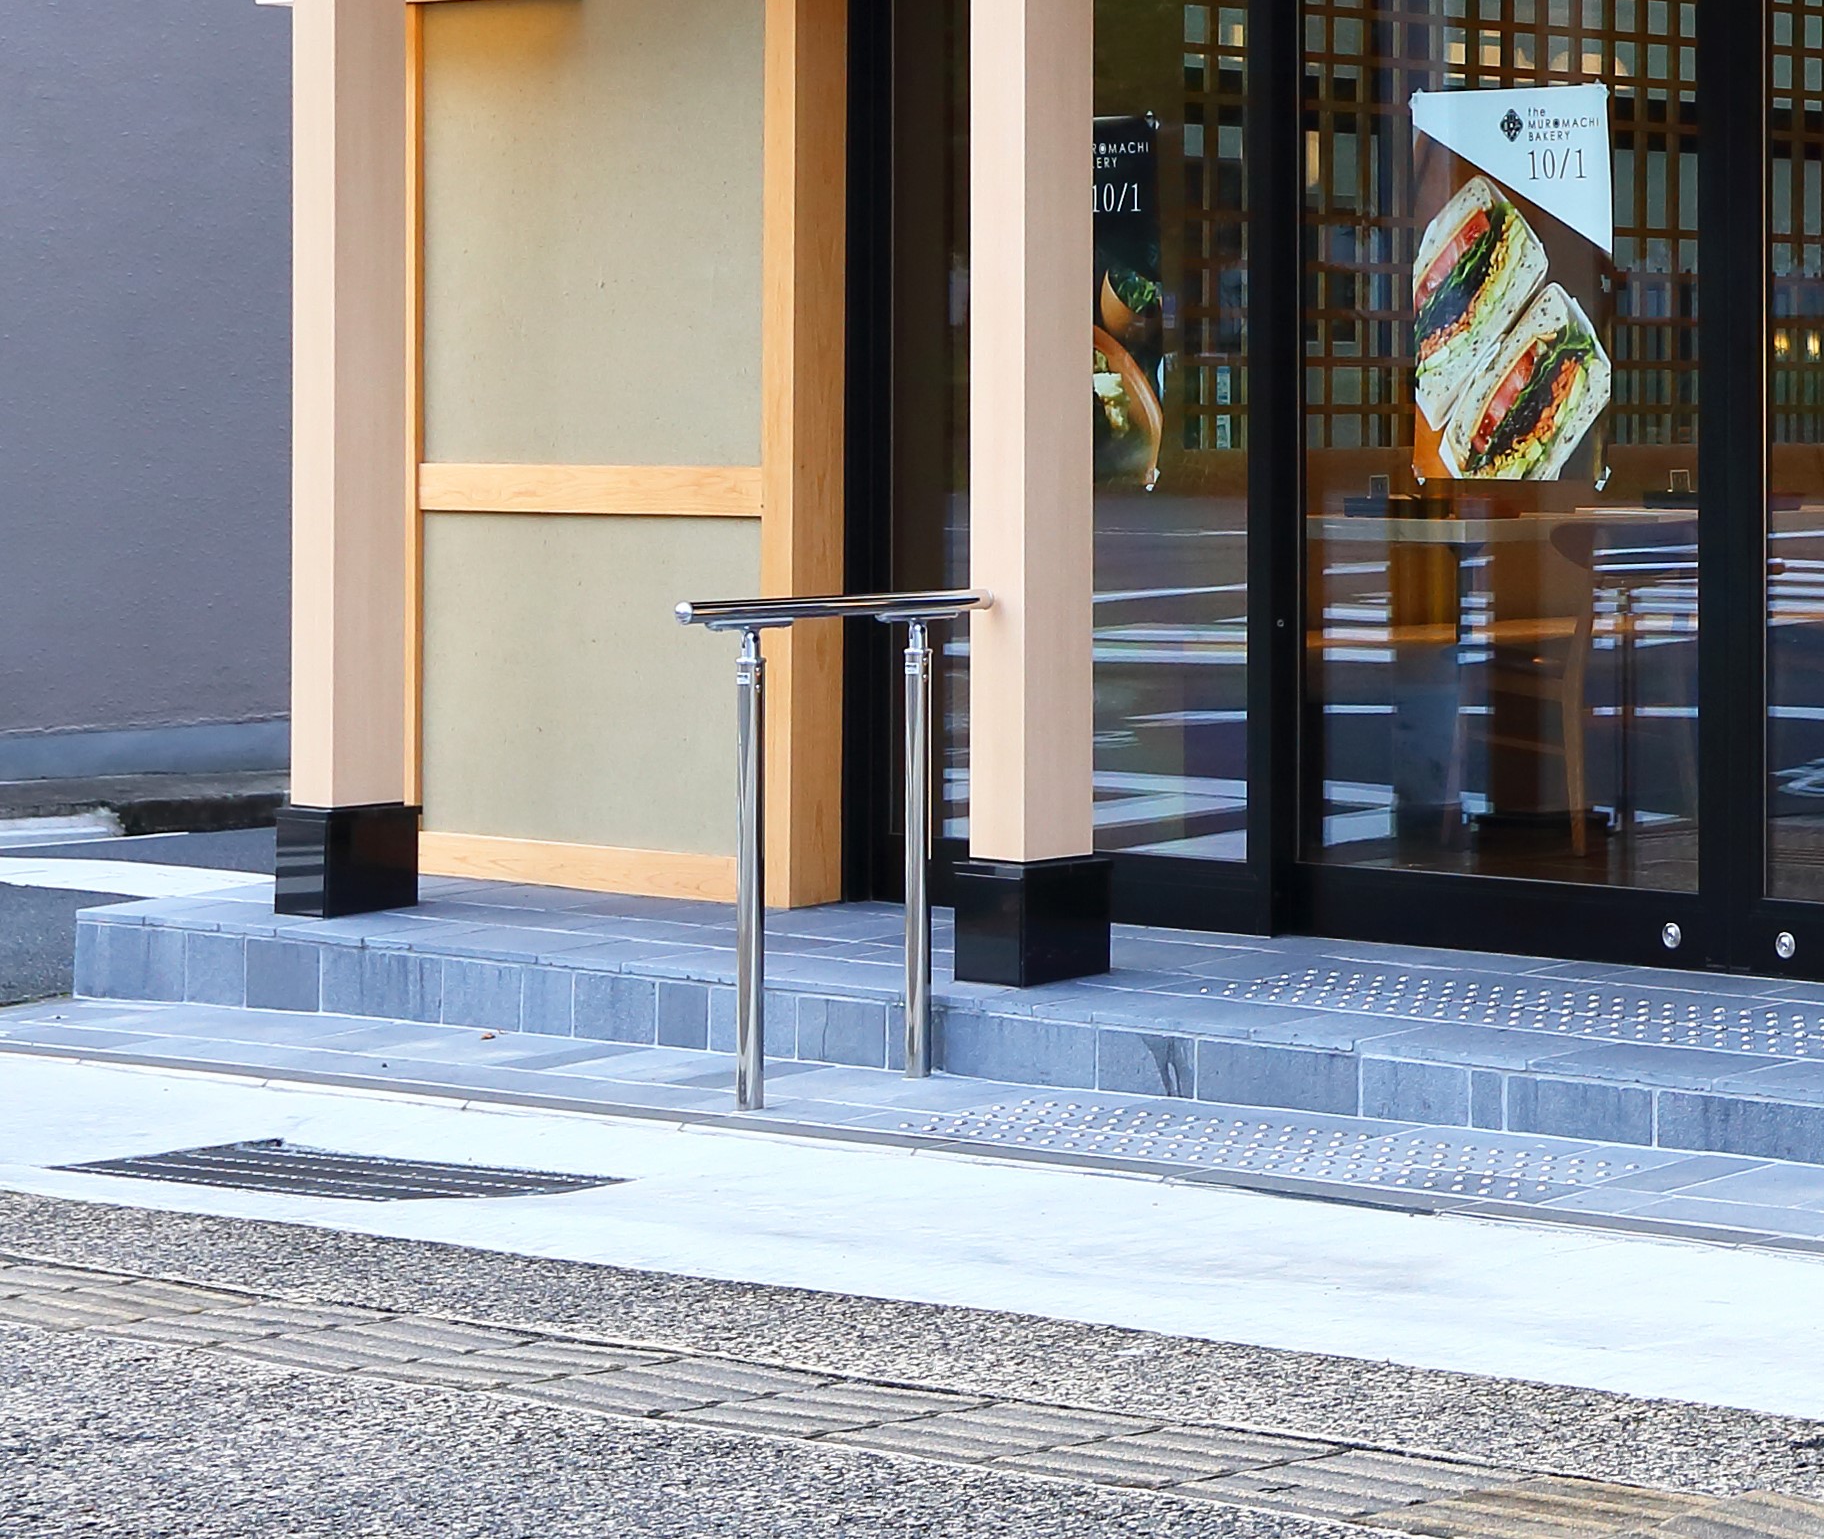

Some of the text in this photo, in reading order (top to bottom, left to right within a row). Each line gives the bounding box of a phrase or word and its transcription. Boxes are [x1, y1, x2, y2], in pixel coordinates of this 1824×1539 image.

[1528, 107, 1546, 117] the
[1528, 117, 1599, 129] MUROMACHI
[1528, 130, 1570, 142] BAKERY
[1527, 148, 1586, 180] 10/1
[1092, 182, 1141, 213] 10/1
